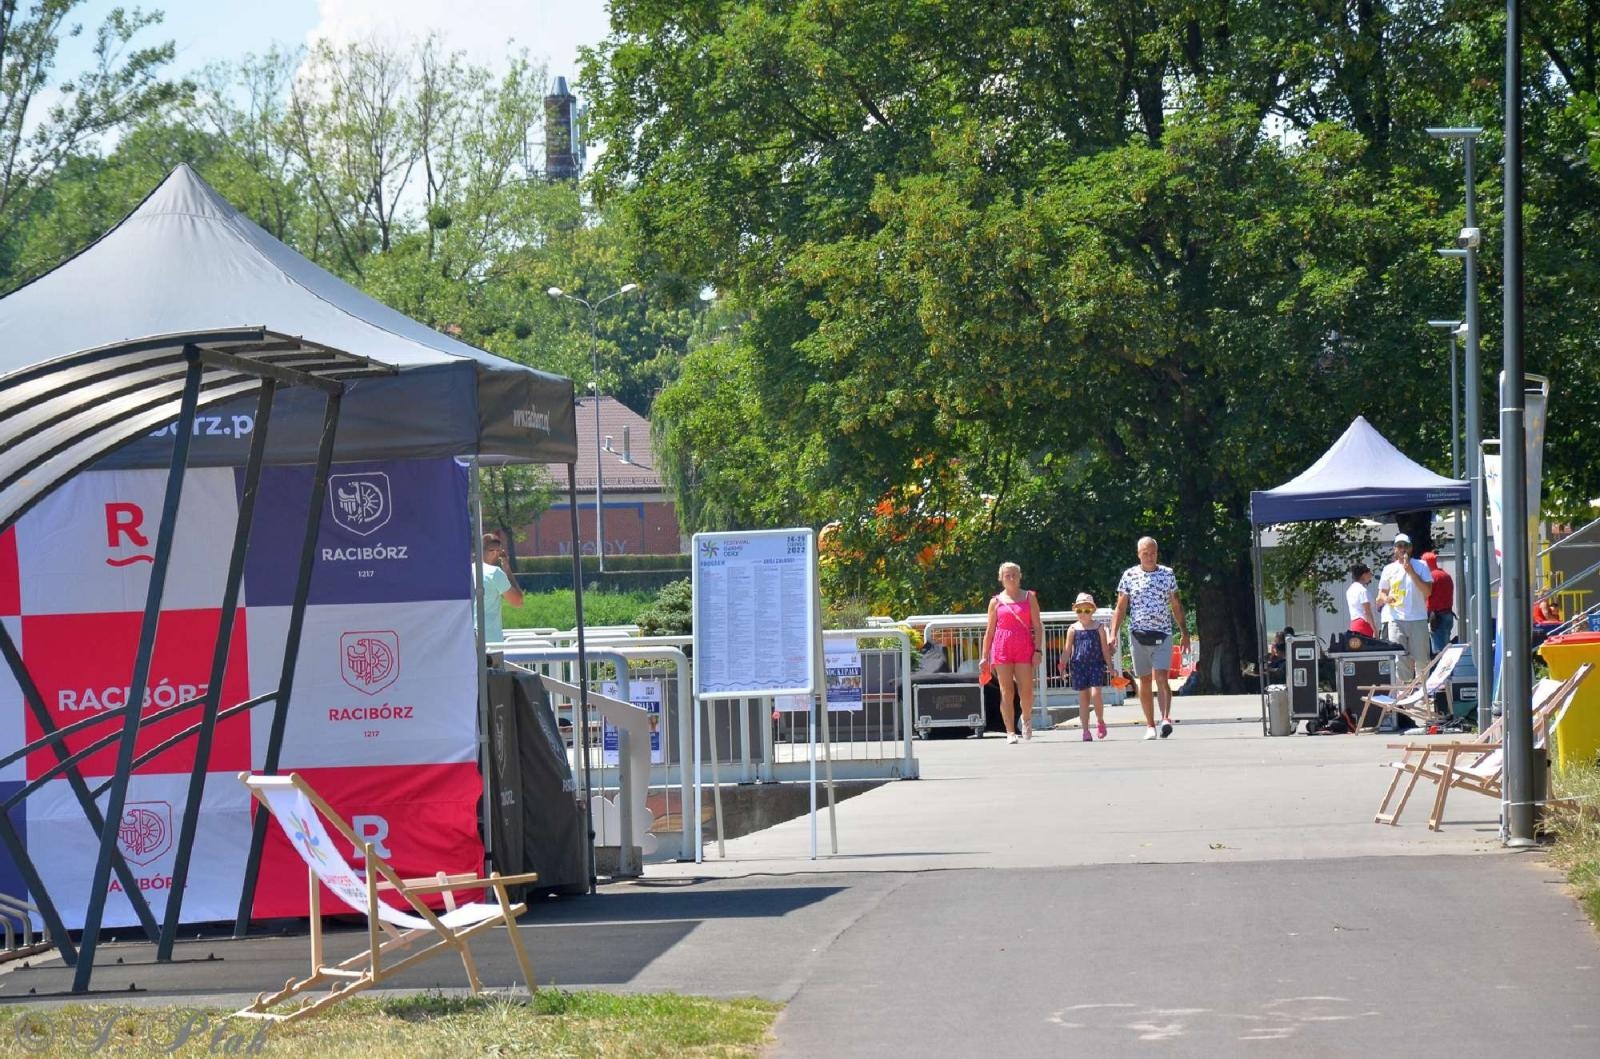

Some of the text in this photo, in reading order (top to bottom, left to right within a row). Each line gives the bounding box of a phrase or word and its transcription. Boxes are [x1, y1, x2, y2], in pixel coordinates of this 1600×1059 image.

[105, 503, 149, 547] R
[322, 543, 408, 561] RACIBÓRZ
[358, 570, 375, 578] 1217
[329, 703, 414, 721] RACIBÓRZ
[363, 730, 380, 738] 1217
[352, 814, 391, 860] R
